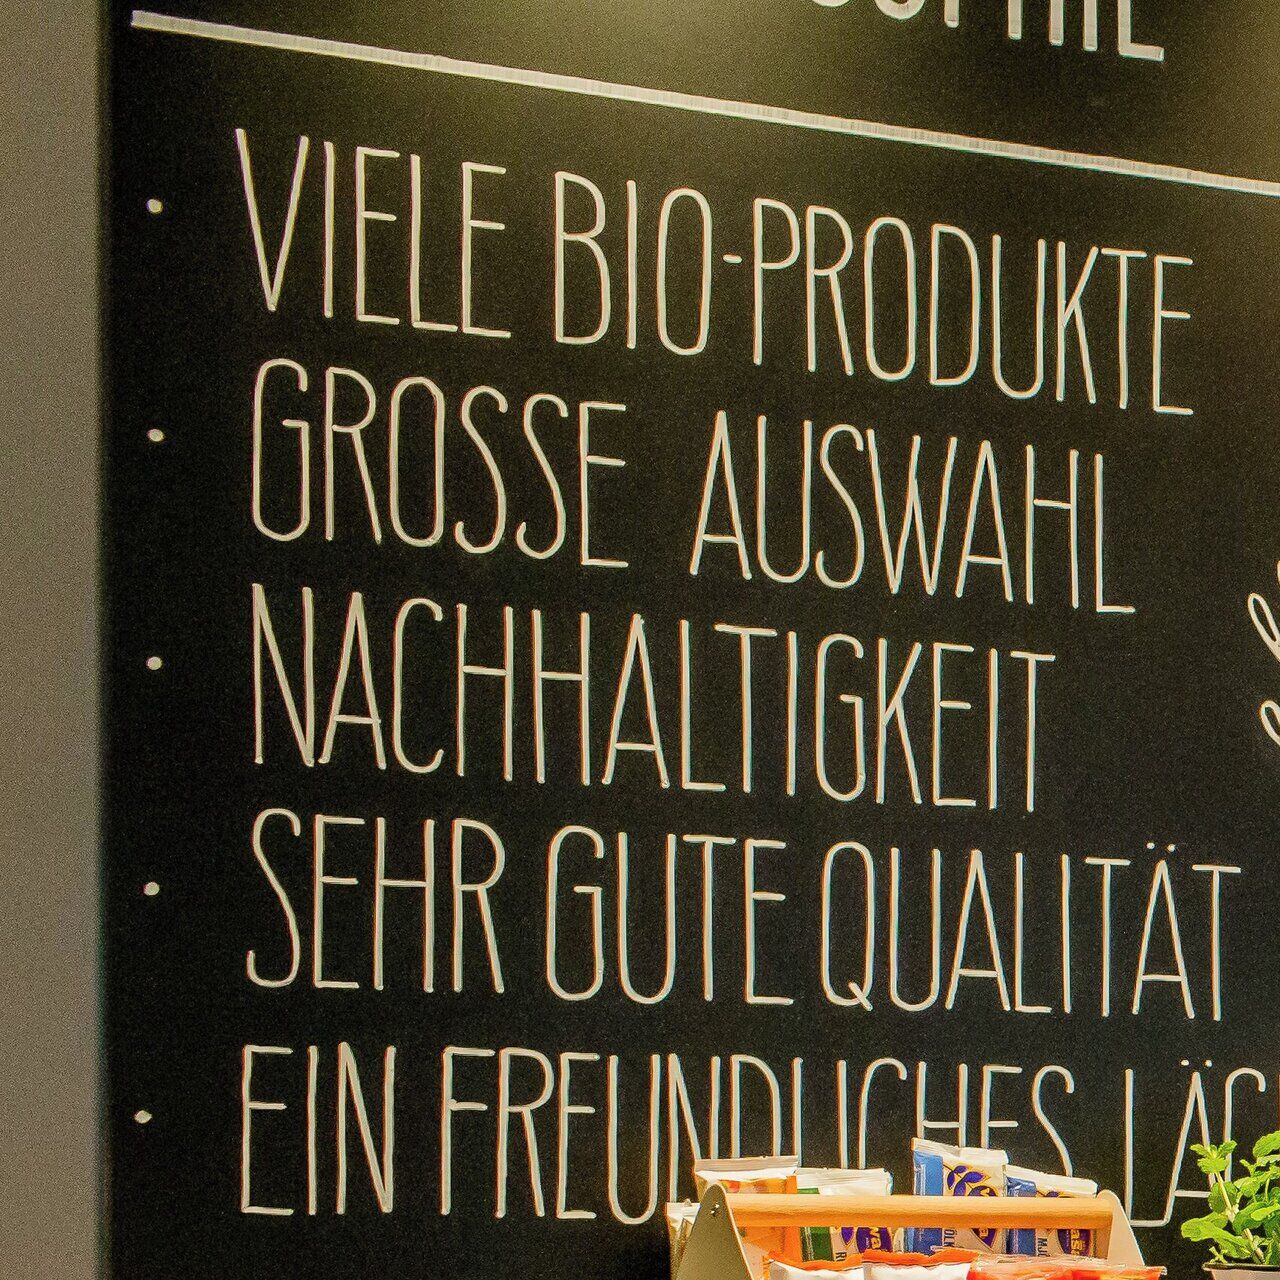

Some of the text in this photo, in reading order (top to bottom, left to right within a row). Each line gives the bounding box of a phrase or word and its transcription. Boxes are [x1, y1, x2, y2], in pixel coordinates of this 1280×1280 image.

[234, 127, 1195, 418] VIELE BIO-PRODUKTE
[250, 356, 1136, 615] GROSSE AUSWAHL
[251, 582, 1057, 812] NACHHALTIGKEIT
[245, 806, 1242, 1023] SEHR GUTE QUALITÄT
[240, 1042, 398, 1218] EIN
[439, 1044, 1076, 1226] FREUNDLICHES
